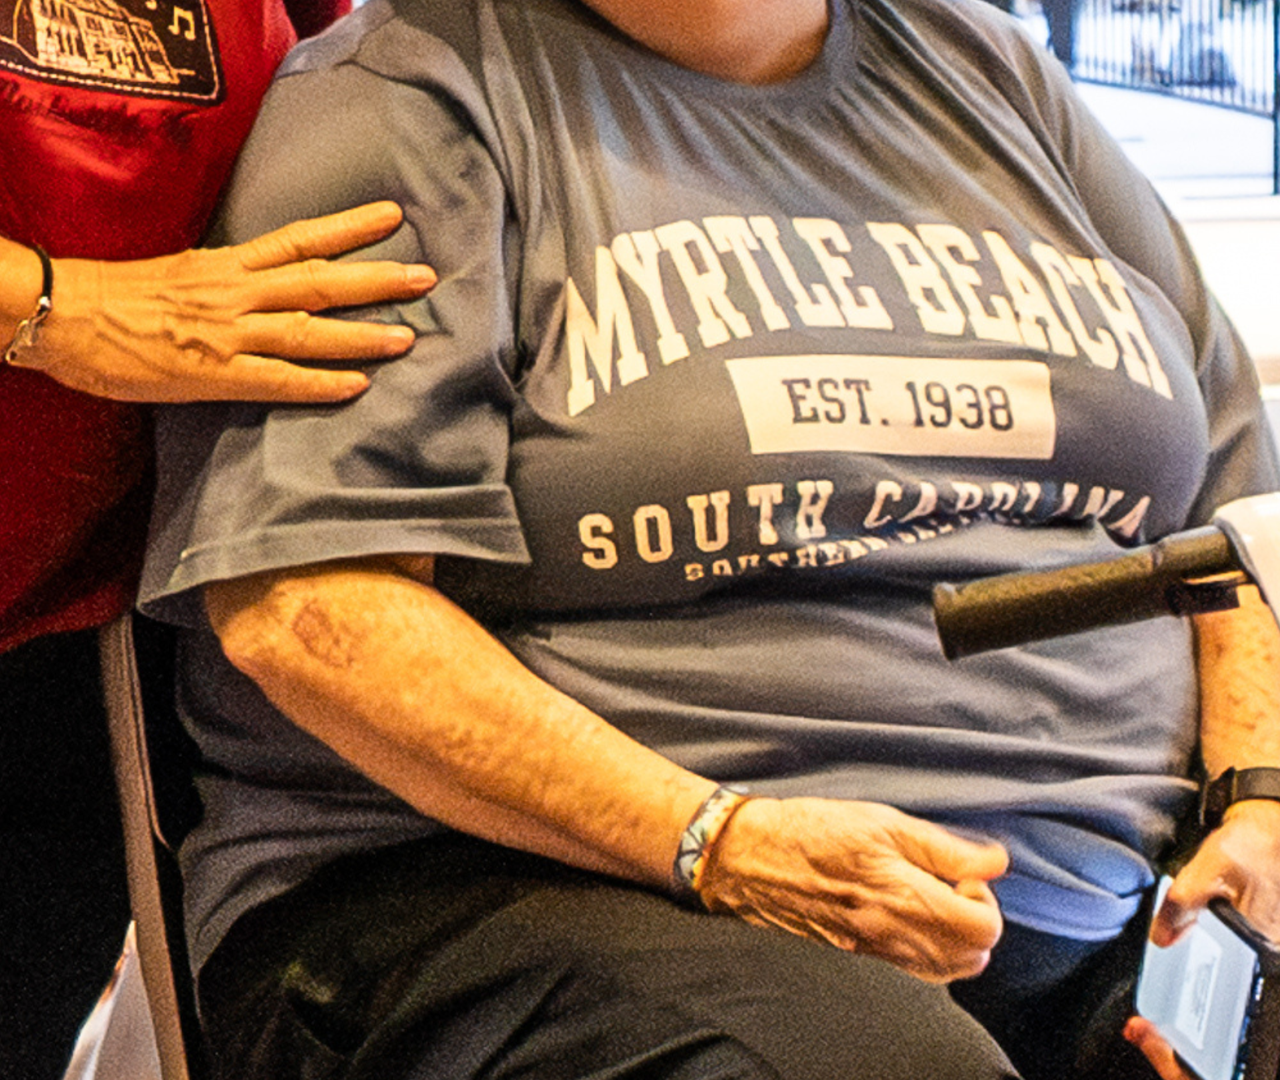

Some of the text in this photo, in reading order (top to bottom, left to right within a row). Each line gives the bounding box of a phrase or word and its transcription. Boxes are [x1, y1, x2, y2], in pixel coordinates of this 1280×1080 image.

[566, 214, 1174, 418] MYRTLE BEACH
[781, 377, 1014, 432] EST. 1938
[577, 479, 835, 570] SOUTH
